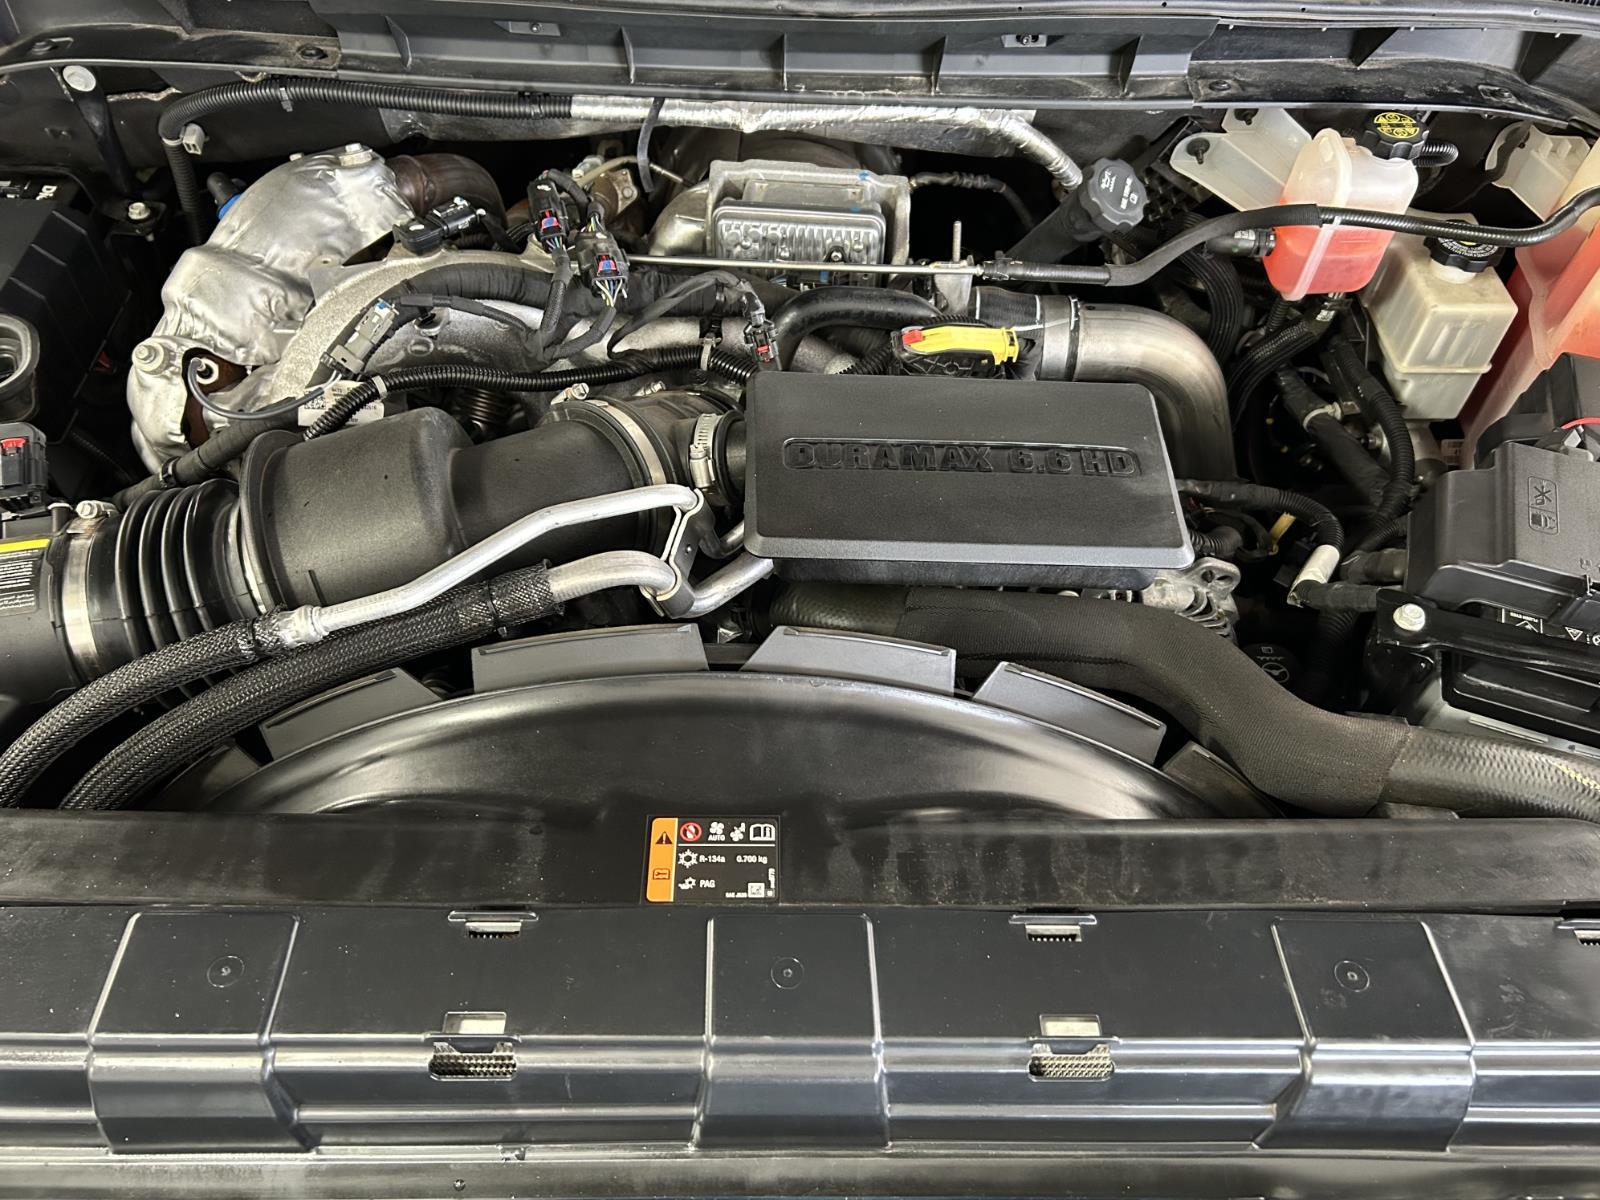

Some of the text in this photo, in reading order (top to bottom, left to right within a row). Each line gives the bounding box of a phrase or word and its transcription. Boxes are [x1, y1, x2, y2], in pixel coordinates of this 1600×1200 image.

[784, 443, 1136, 476] DURAMAX 6.6 HD
[699, 855, 768, 864] R-134a 0.700 kg
[699, 879, 716, 888] PAG
